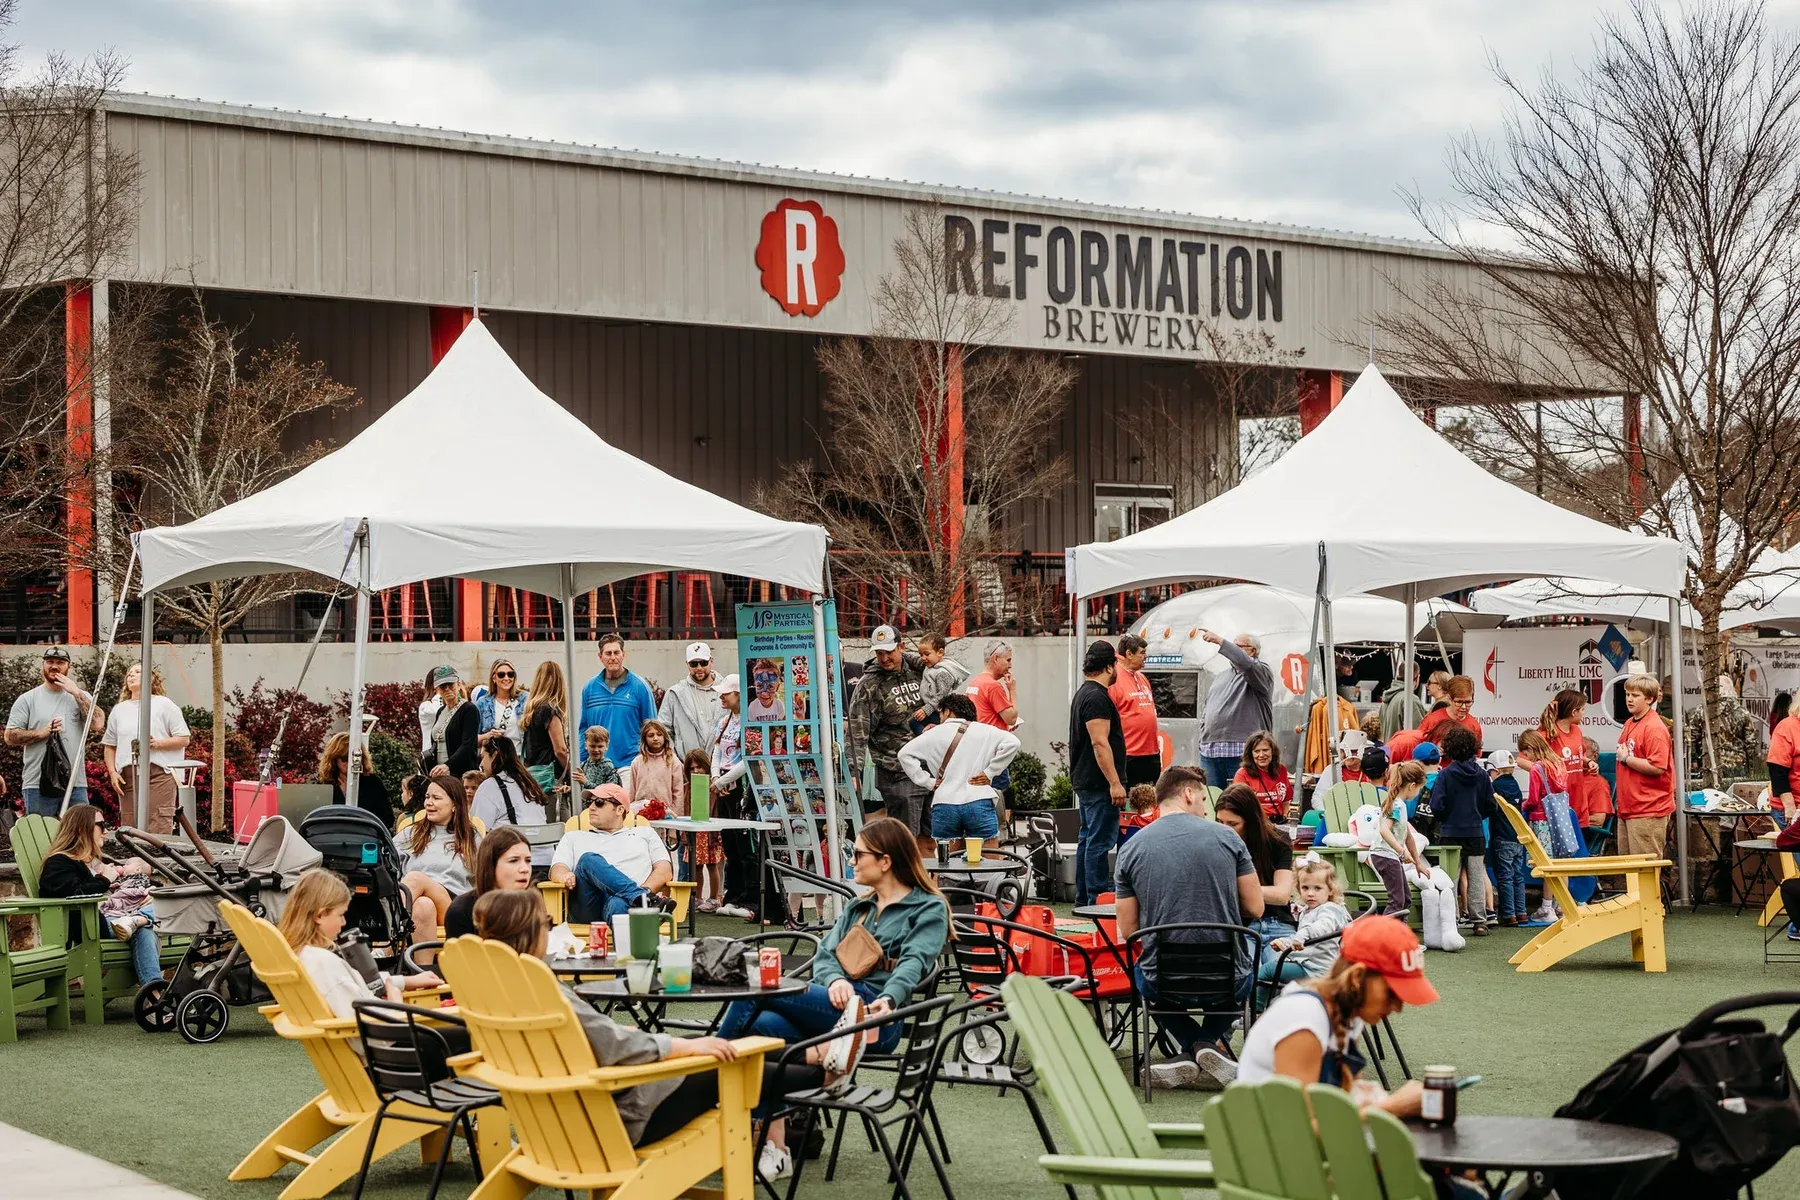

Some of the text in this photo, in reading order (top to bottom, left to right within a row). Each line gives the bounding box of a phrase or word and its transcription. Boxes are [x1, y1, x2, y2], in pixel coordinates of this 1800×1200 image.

[785, 208, 818, 306] R
[944, 214, 1283, 323] REFORMATION
[1043, 304, 1205, 351] BREWERY
[749, 644, 774, 652] Corporate
[780, 642, 808, 650] Community
[754, 635, 775, 643] Birthday
[776, 634, 793, 642] Parties
[797, 633, 814, 641] Reunio
[1290, 657, 1304, 690] R
[1579, 665, 1603, 678] UMC
[1501, 716, 1540, 726] MORNINGS
